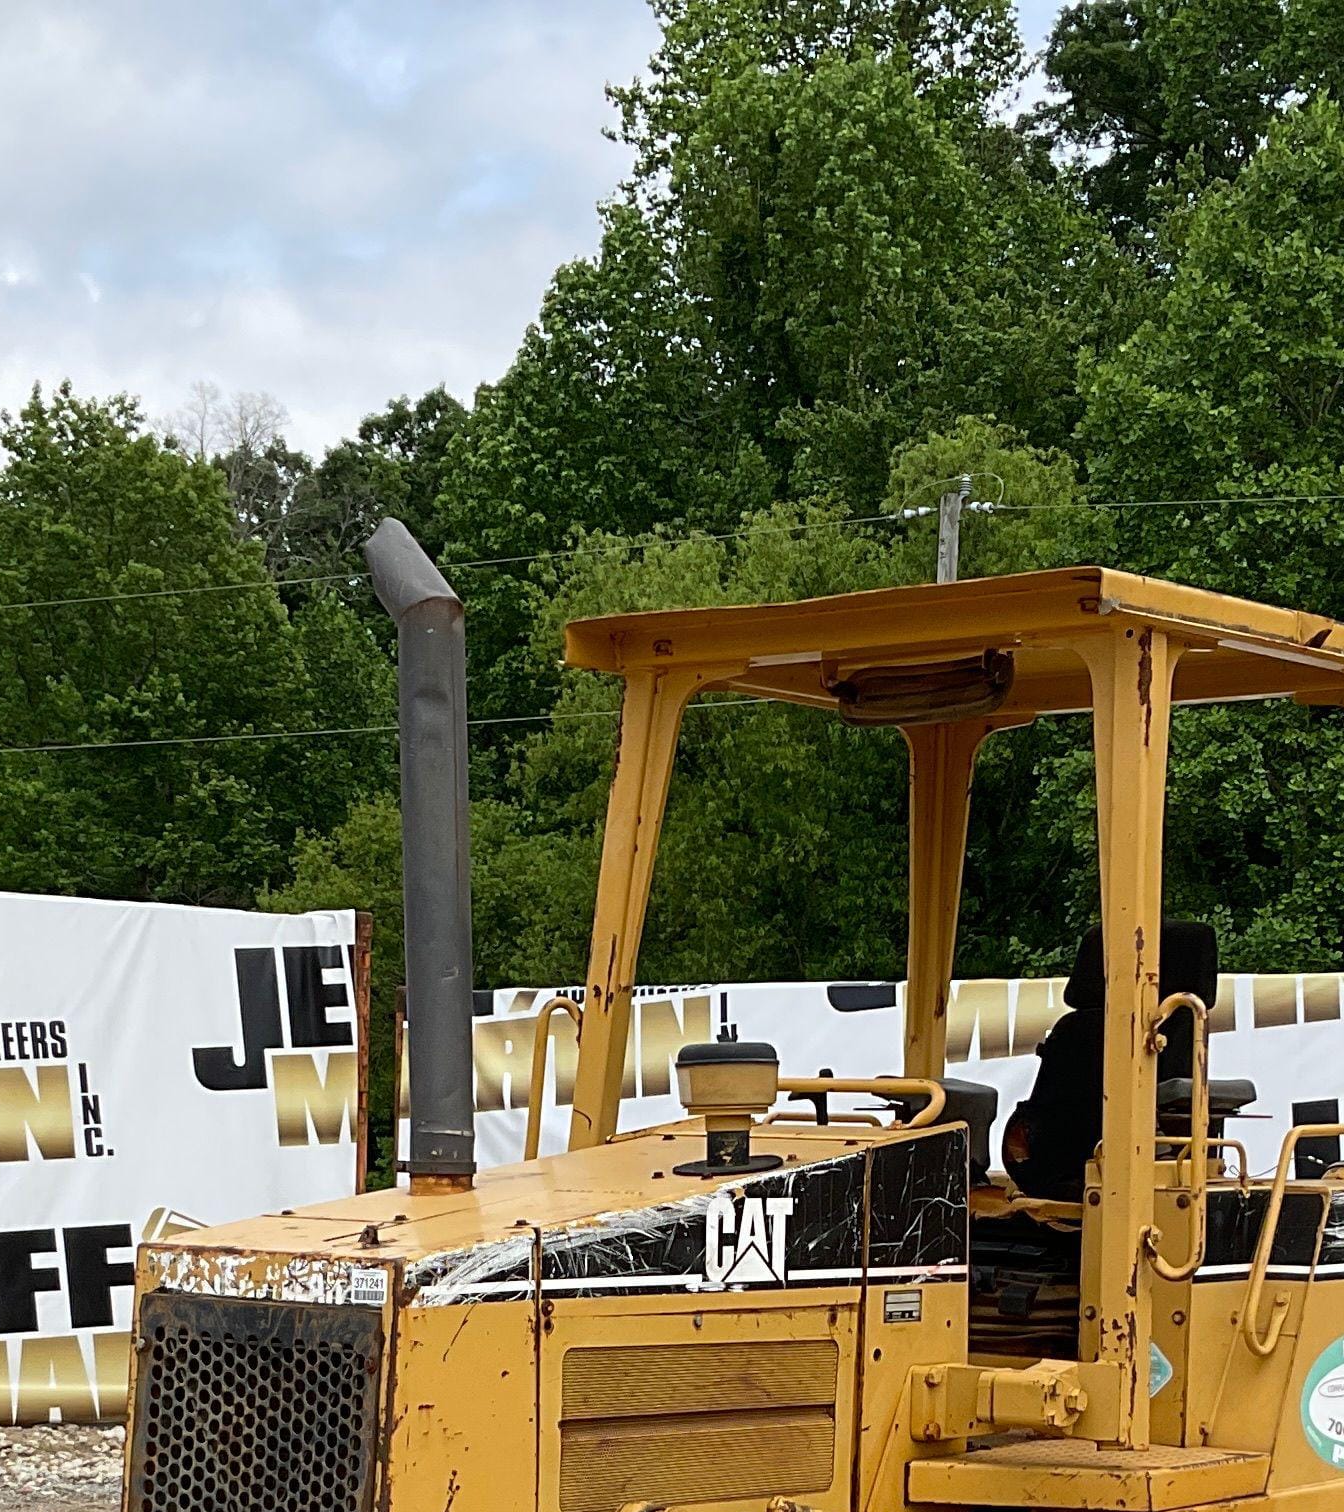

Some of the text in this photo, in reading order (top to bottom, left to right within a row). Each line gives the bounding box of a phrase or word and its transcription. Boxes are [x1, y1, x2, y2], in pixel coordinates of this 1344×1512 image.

[192, 944, 355, 1091] JE
[79, 1063, 114, 1157] INC.
[354, 1277, 384, 1289] 371241
[706, 1197, 793, 1282] CAT
